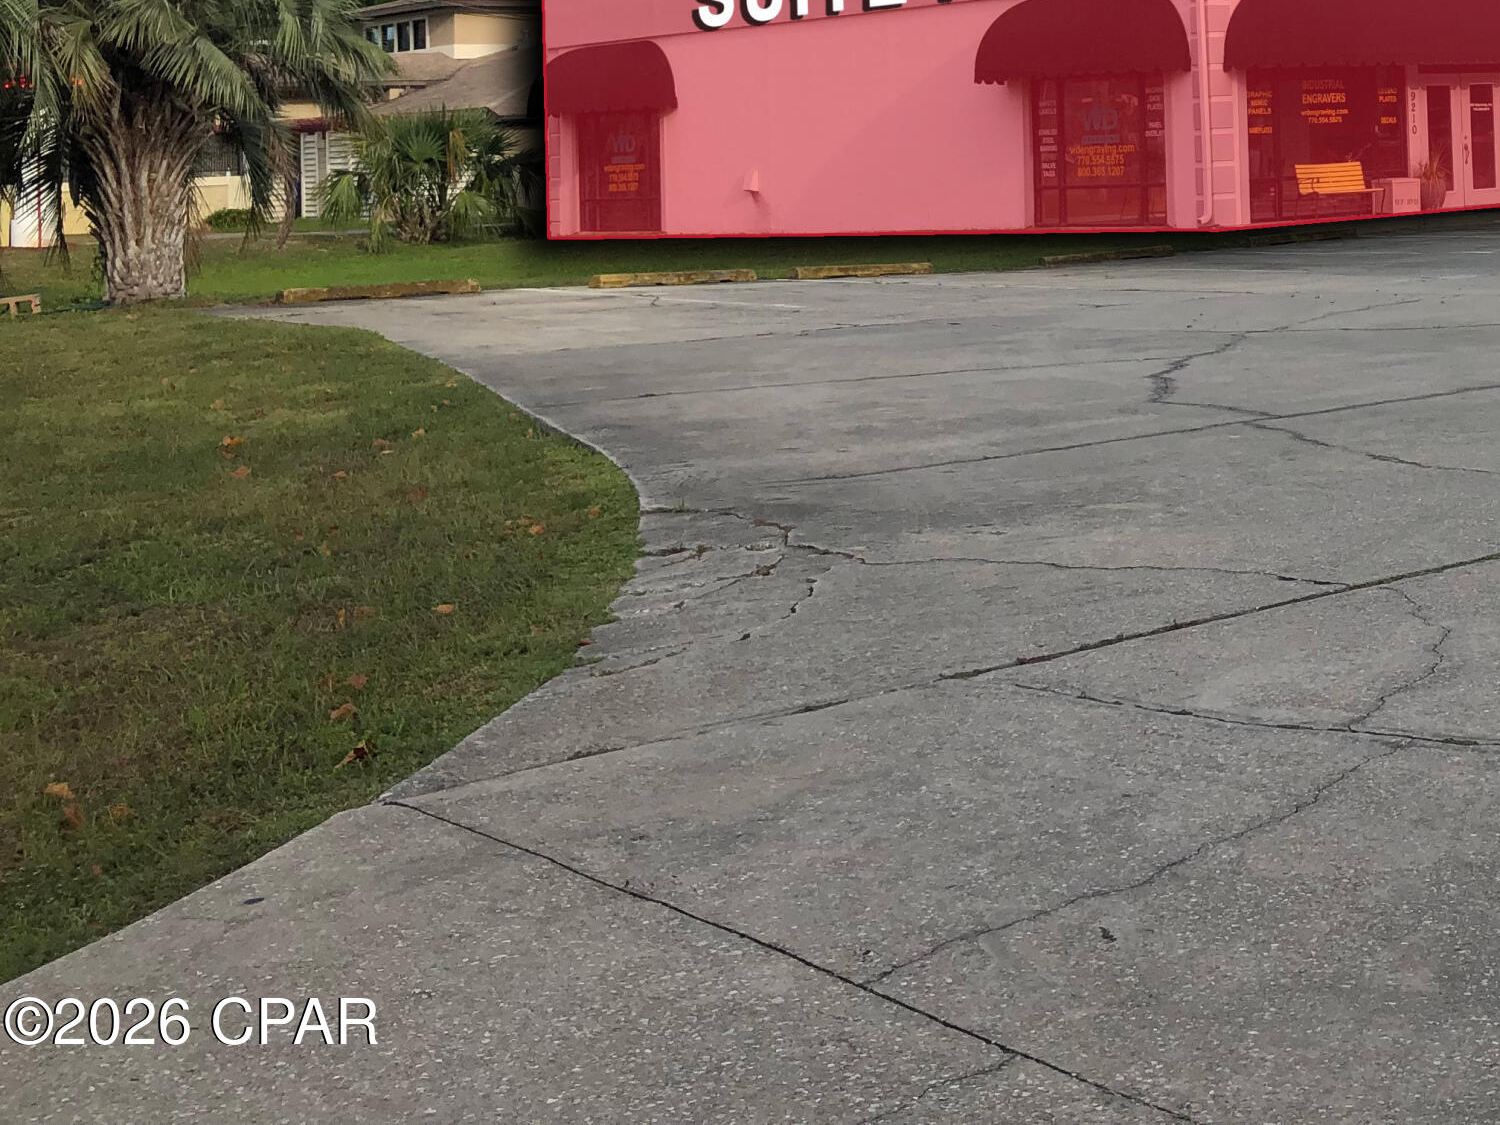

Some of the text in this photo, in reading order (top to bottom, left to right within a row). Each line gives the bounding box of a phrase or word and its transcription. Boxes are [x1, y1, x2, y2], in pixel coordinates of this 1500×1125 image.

[1302, 79, 1345, 90] INDUSTRIAL
[1302, 93, 1346, 104] ENGRAVERS
[1247, 107, 1272, 115] PANELS
[1410, 91, 1418, 135] 9210
[1070, 145, 1135, 155] wdengraving.com
[1077, 155, 1125, 165] 770.554.5575
[1078, 166, 1124, 176] 800.365.1207
